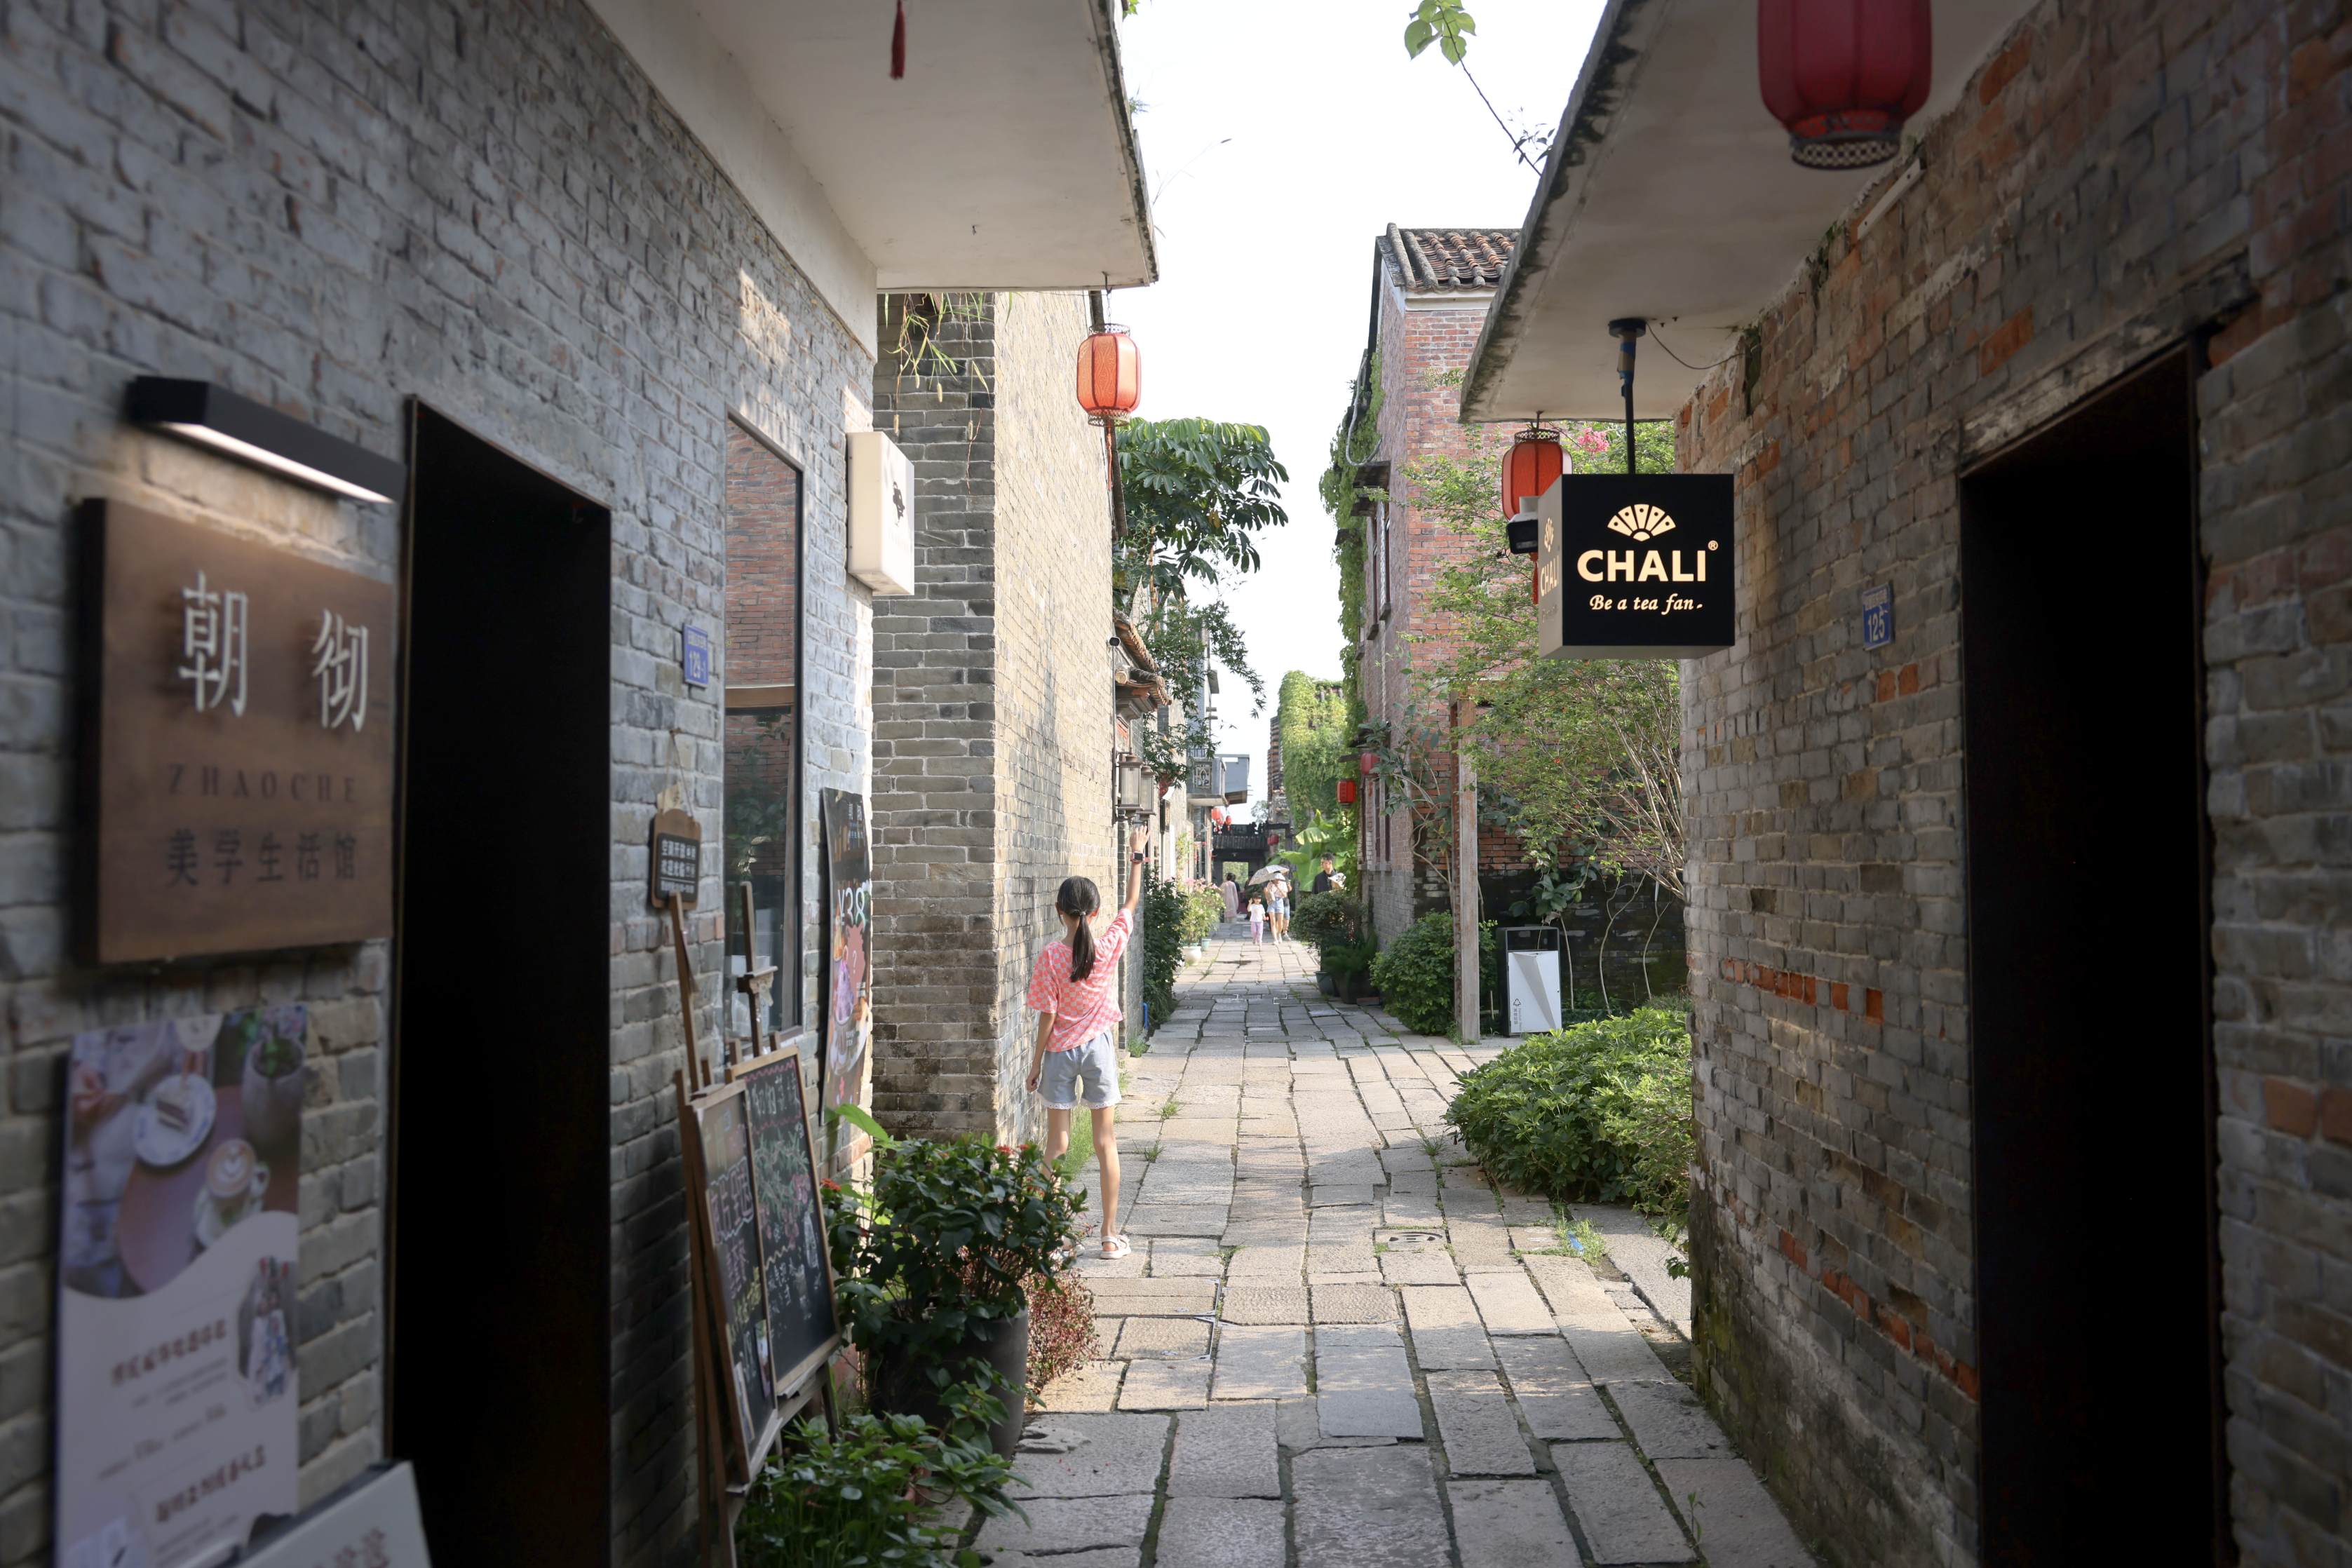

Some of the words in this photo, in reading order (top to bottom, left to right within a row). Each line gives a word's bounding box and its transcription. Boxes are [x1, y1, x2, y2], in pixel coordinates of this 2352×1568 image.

[1540, 555, 1560, 597] CHALI
[1589, 594, 1613, 610] Be
[1617, 598, 1628, 610] a
[1633, 597, 1659, 610] tea
[1867, 610, 1886, 643] 125
[168, 762, 356, 804] ZHAOCHE
[167, 827, 357, 888] 美学生活馆
